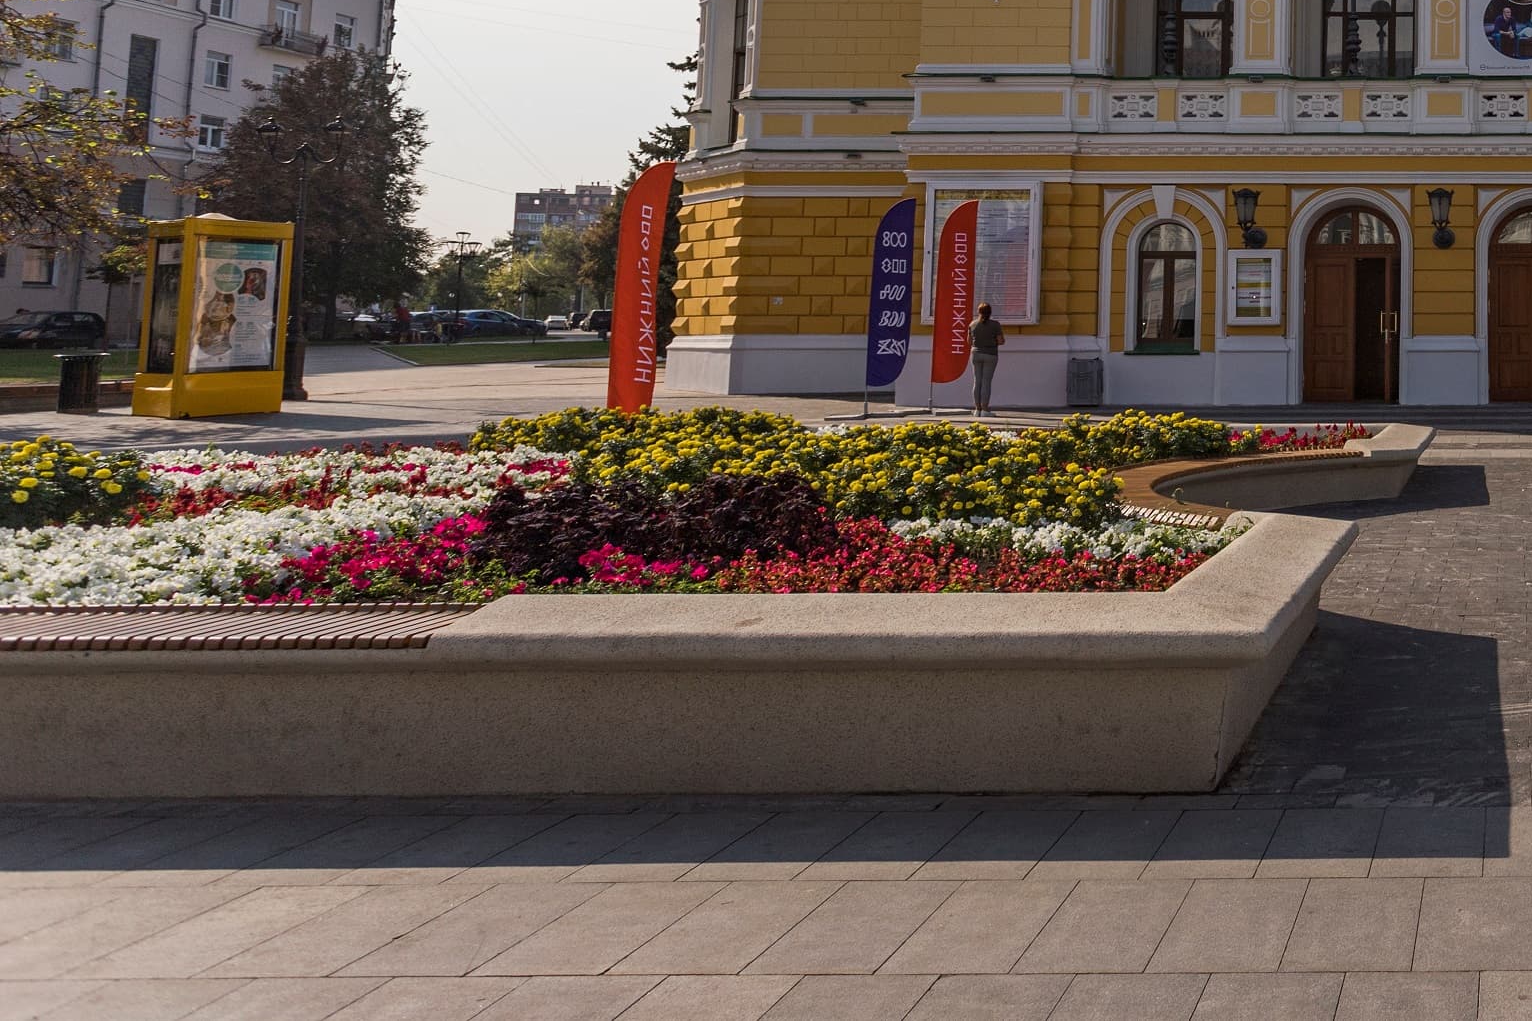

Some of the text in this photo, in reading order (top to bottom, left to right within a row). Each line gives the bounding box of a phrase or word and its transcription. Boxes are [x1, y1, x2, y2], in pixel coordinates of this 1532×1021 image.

[881, 259, 907, 274] 800
[882, 231, 907, 248] 800
[633, 257, 656, 384] НИЖНИЙ
[951, 232, 968, 355] НИЖНИЙ 800
